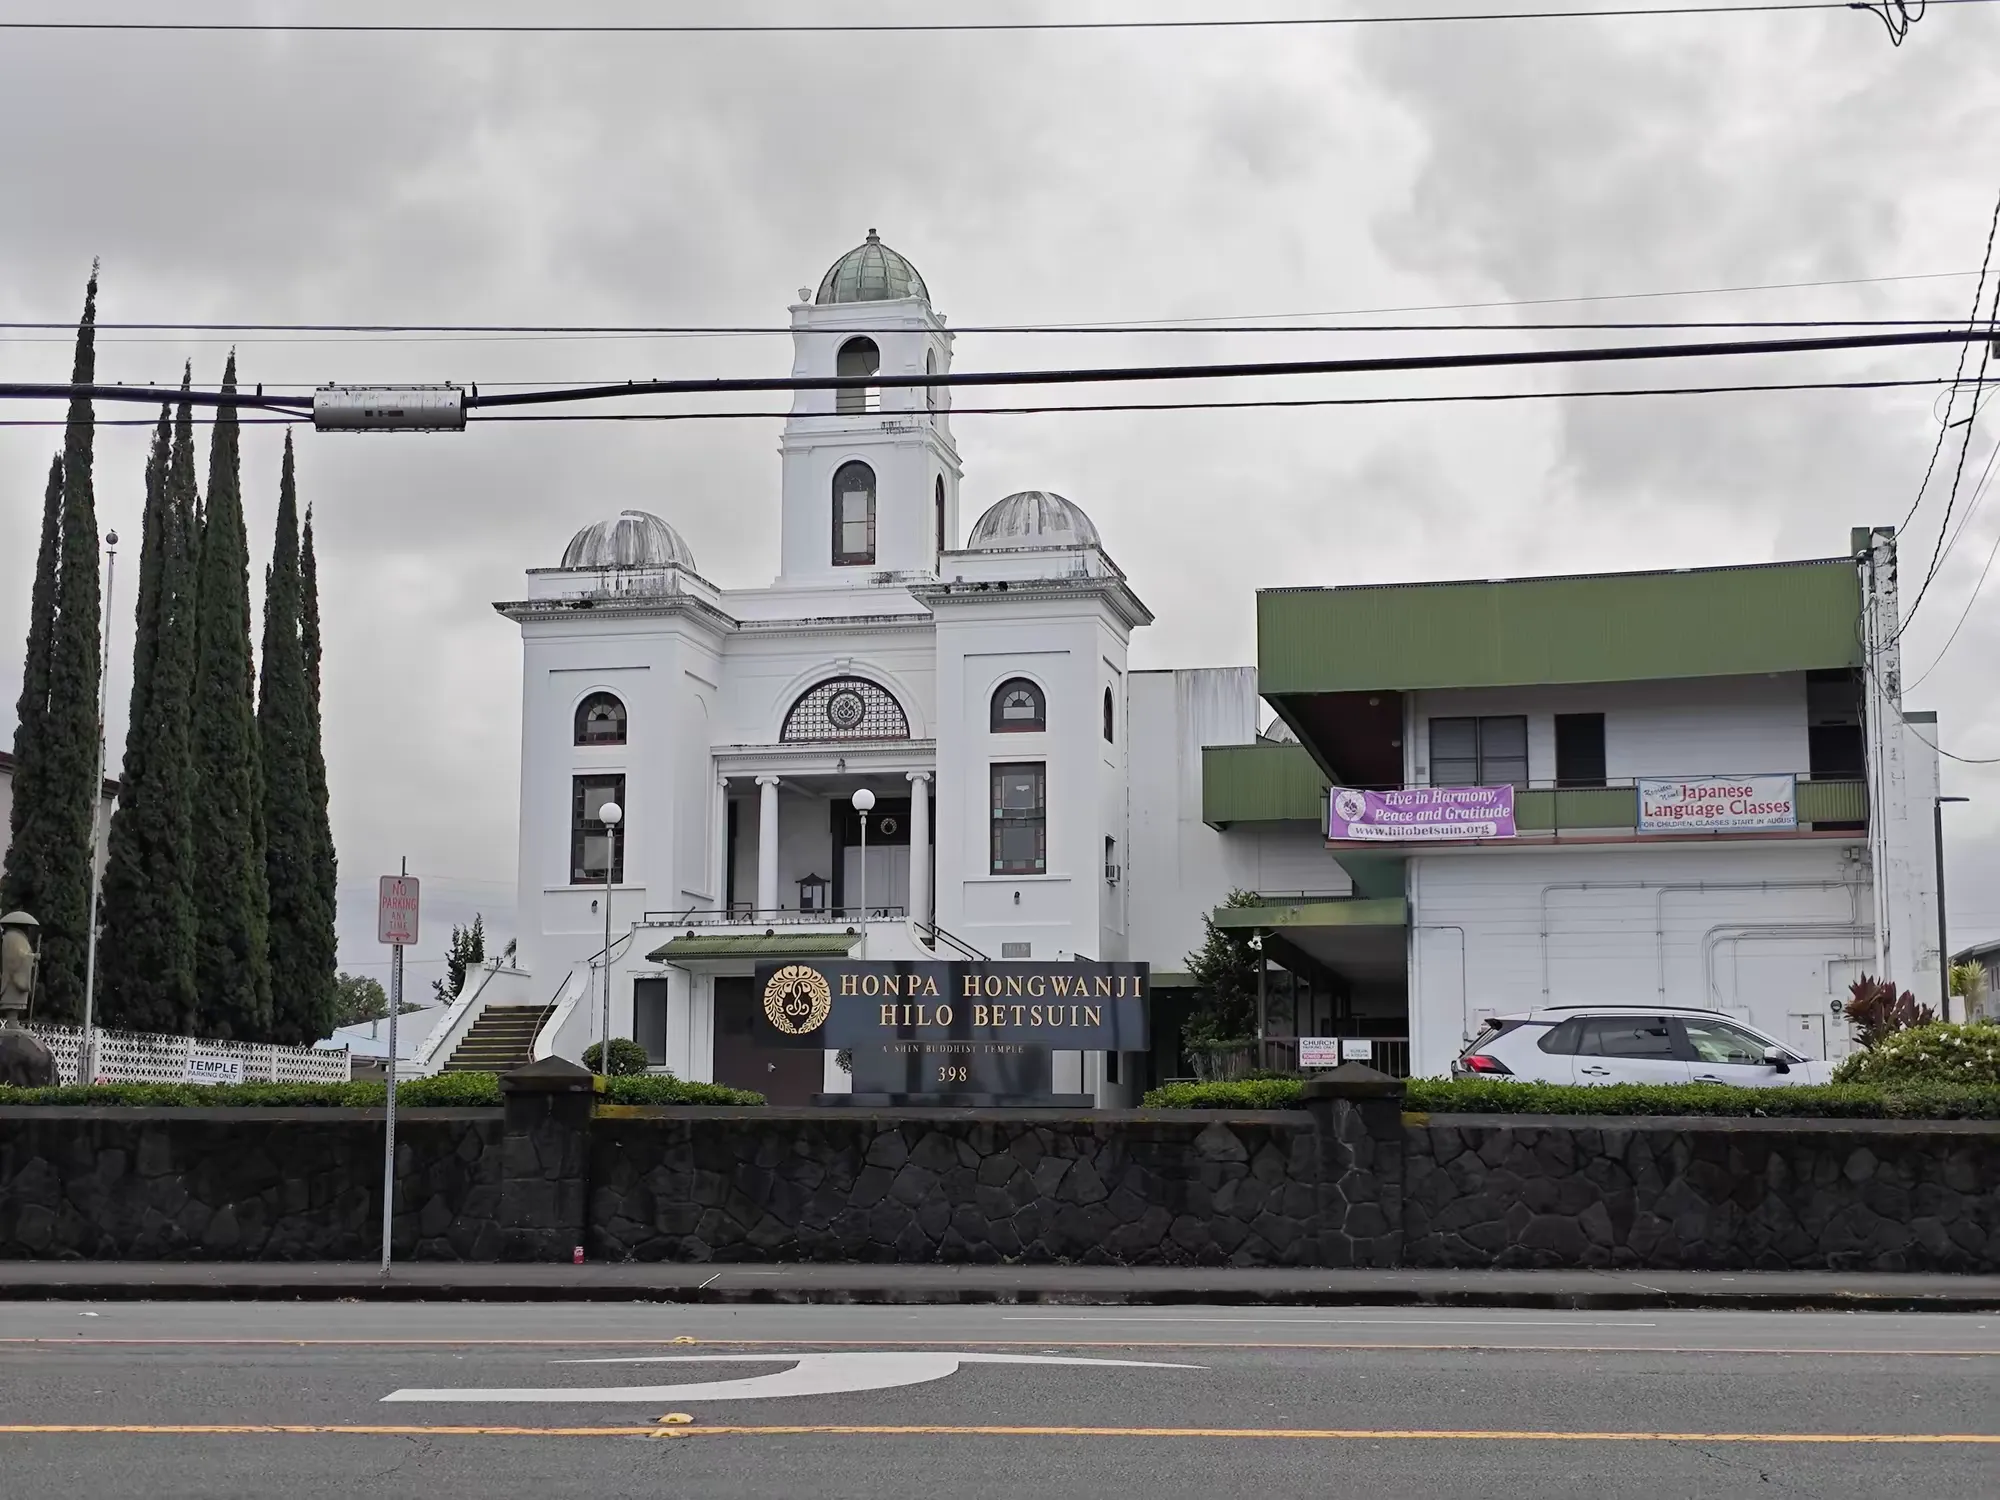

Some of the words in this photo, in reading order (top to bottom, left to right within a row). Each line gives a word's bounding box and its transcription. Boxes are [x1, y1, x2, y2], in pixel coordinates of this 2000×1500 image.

[1385, 792, 1412, 806] Live
[1416, 791, 1428, 804] in
[1432, 790, 1498, 805] Harmony,
[1680, 784, 1753, 801] Japanese
[1375, 808, 1413, 821] Peace
[1417, 808, 1442, 821] and
[1445, 804, 1511, 820] Gratitude
[1644, 801, 1725, 819] Language
[1729, 799, 1791, 816] Classes
[1695, 819, 1730, 827] CLASSES
[1731, 818, 1754, 826] START
[1767, 817, 1795, 825] AUGUST
[1355, 823, 1490, 837] www.hilobetsuin.org
[392, 883, 407, 896] NO
[382, 896, 417, 911] PARKING
[391, 911, 406, 920] ANY
[390, 920, 408, 929] TIME
[839, 974, 940, 997] HONPA
[962, 975, 1143, 998] HONGWANJI
[879, 1004, 955, 1027] HILO
[973, 1004, 1103, 1027] BETSUIN
[883, 1045, 889, 1053] A
[894, 1045, 920, 1053] SHIN
[926, 1045, 977, 1053] BUDDHIST
[984, 1045, 1025, 1053] TEMPLE
[190, 1060, 238, 1073] TEMPLE
[188, 1070, 218, 1078] PARKING
[937, 1067, 968, 1082] 398
